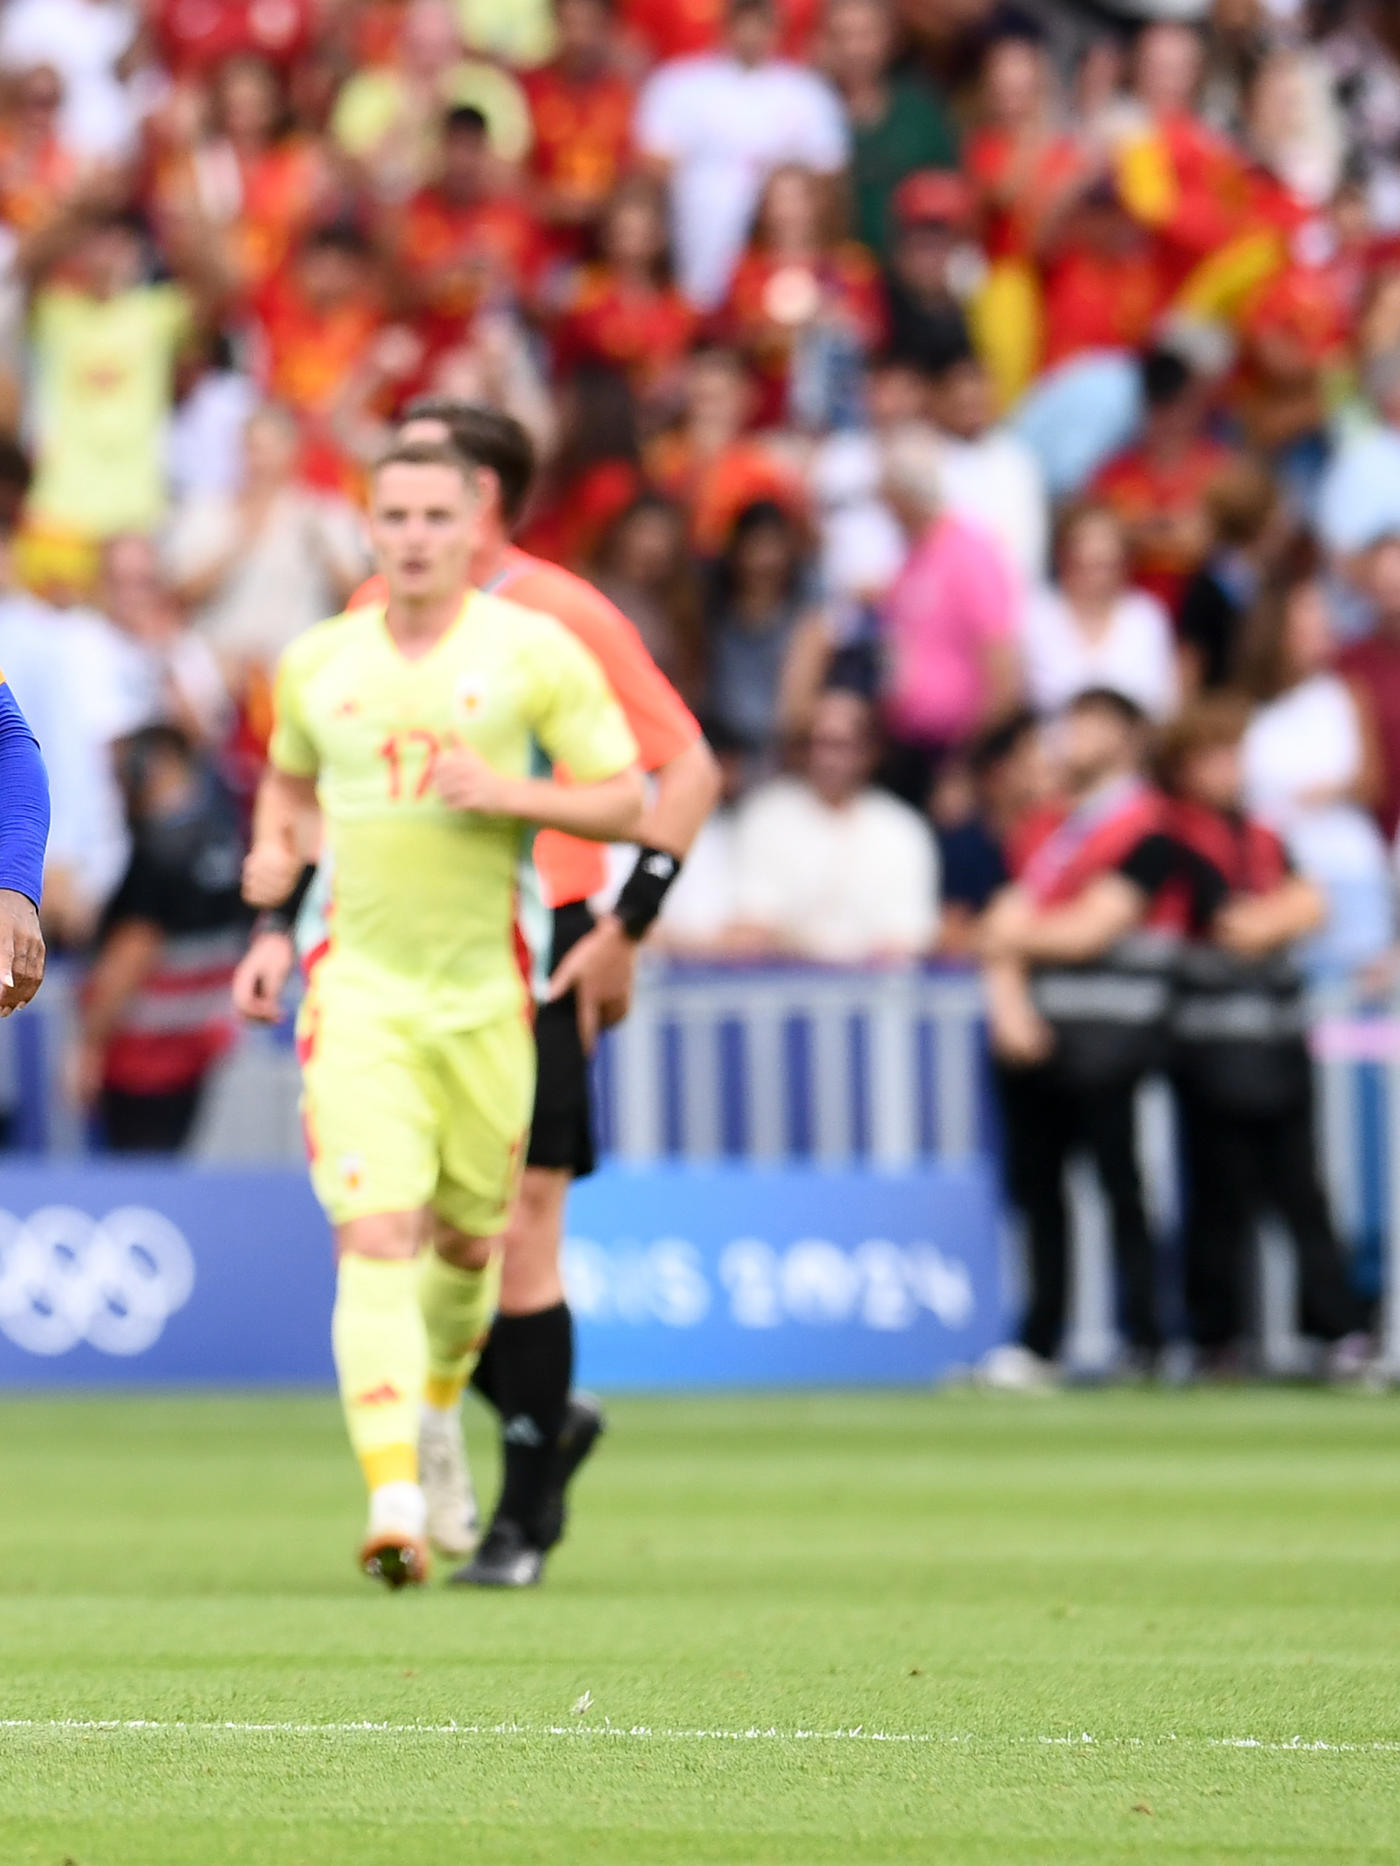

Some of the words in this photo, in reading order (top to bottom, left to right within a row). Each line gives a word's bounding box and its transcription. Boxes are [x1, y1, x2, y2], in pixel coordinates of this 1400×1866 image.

[379, 729, 441, 802] 17
[562, 1239, 708, 1328] RIS
[719, 1238, 974, 1331] 2024
